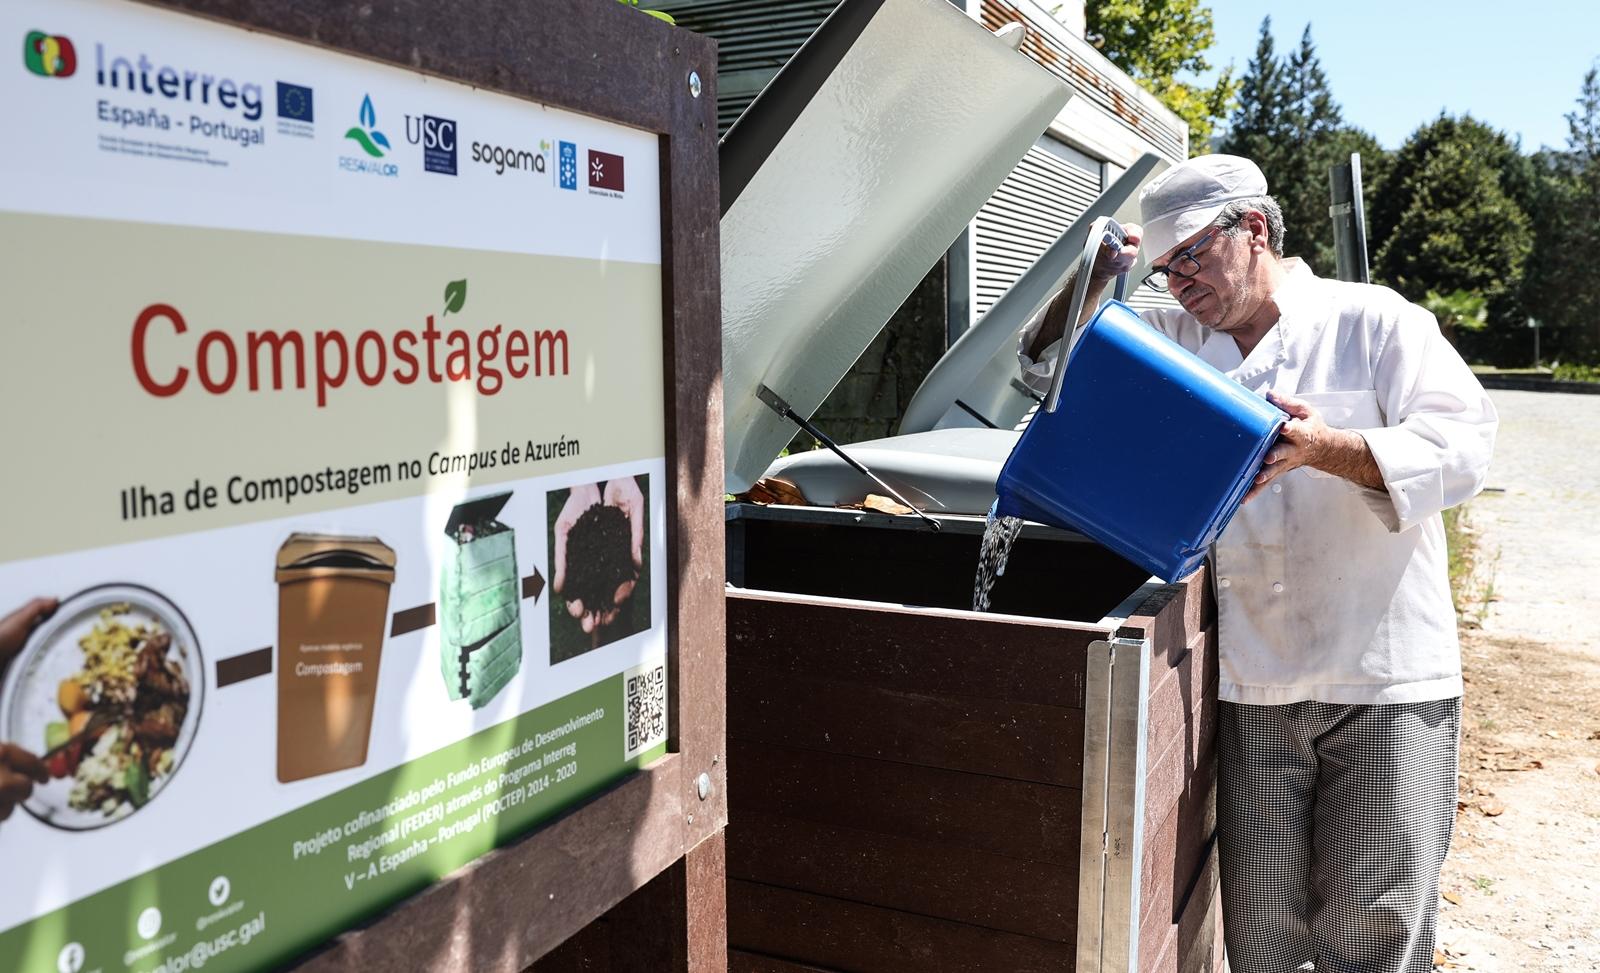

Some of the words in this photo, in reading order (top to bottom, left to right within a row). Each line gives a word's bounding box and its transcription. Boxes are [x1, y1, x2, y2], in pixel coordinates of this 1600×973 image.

[95, 43, 263, 121] Interreg
[97, 100, 170, 130] España
[190, 115, 264, 147] Portugal
[404, 114, 454, 152] USC
[471, 140, 546, 175] sogama
[130, 302, 570, 407] Compostagem
[121, 485, 175, 521] Ilha
[184, 478, 218, 511] de
[227, 462, 392, 505] Compostagem
[398, 459, 422, 481] no
[428, 449, 497, 476] Campus
[501, 441, 520, 465] de
[525, 434, 580, 463] Azurém
[293, 827, 342, 860] Projeto
[344, 790, 420, 836] cofinanciado
[421, 778, 446, 805] pelo
[447, 763, 480, 789] Fundo
[481, 747, 521, 774] Europeu
[522, 739, 534, 754] de
[535, 707, 605, 748] Desenvolvimento
[344, 872, 356, 891] V
[367, 862, 379, 880] A
[379, 838, 428, 874] Espanha
[438, 809, 481, 842] Portugal
[482, 788, 526, 823] (POCTEP)
[527, 775, 549, 798] 2014
[556, 761, 577, 784] 2020
[347, 822, 400, 863] Regional
[401, 802, 445, 840] (FEDER)
[446, 786, 483, 815] através
[484, 778, 498, 796] do
[500, 758, 542, 789] Programa
[543, 742, 577, 767] Interreg
